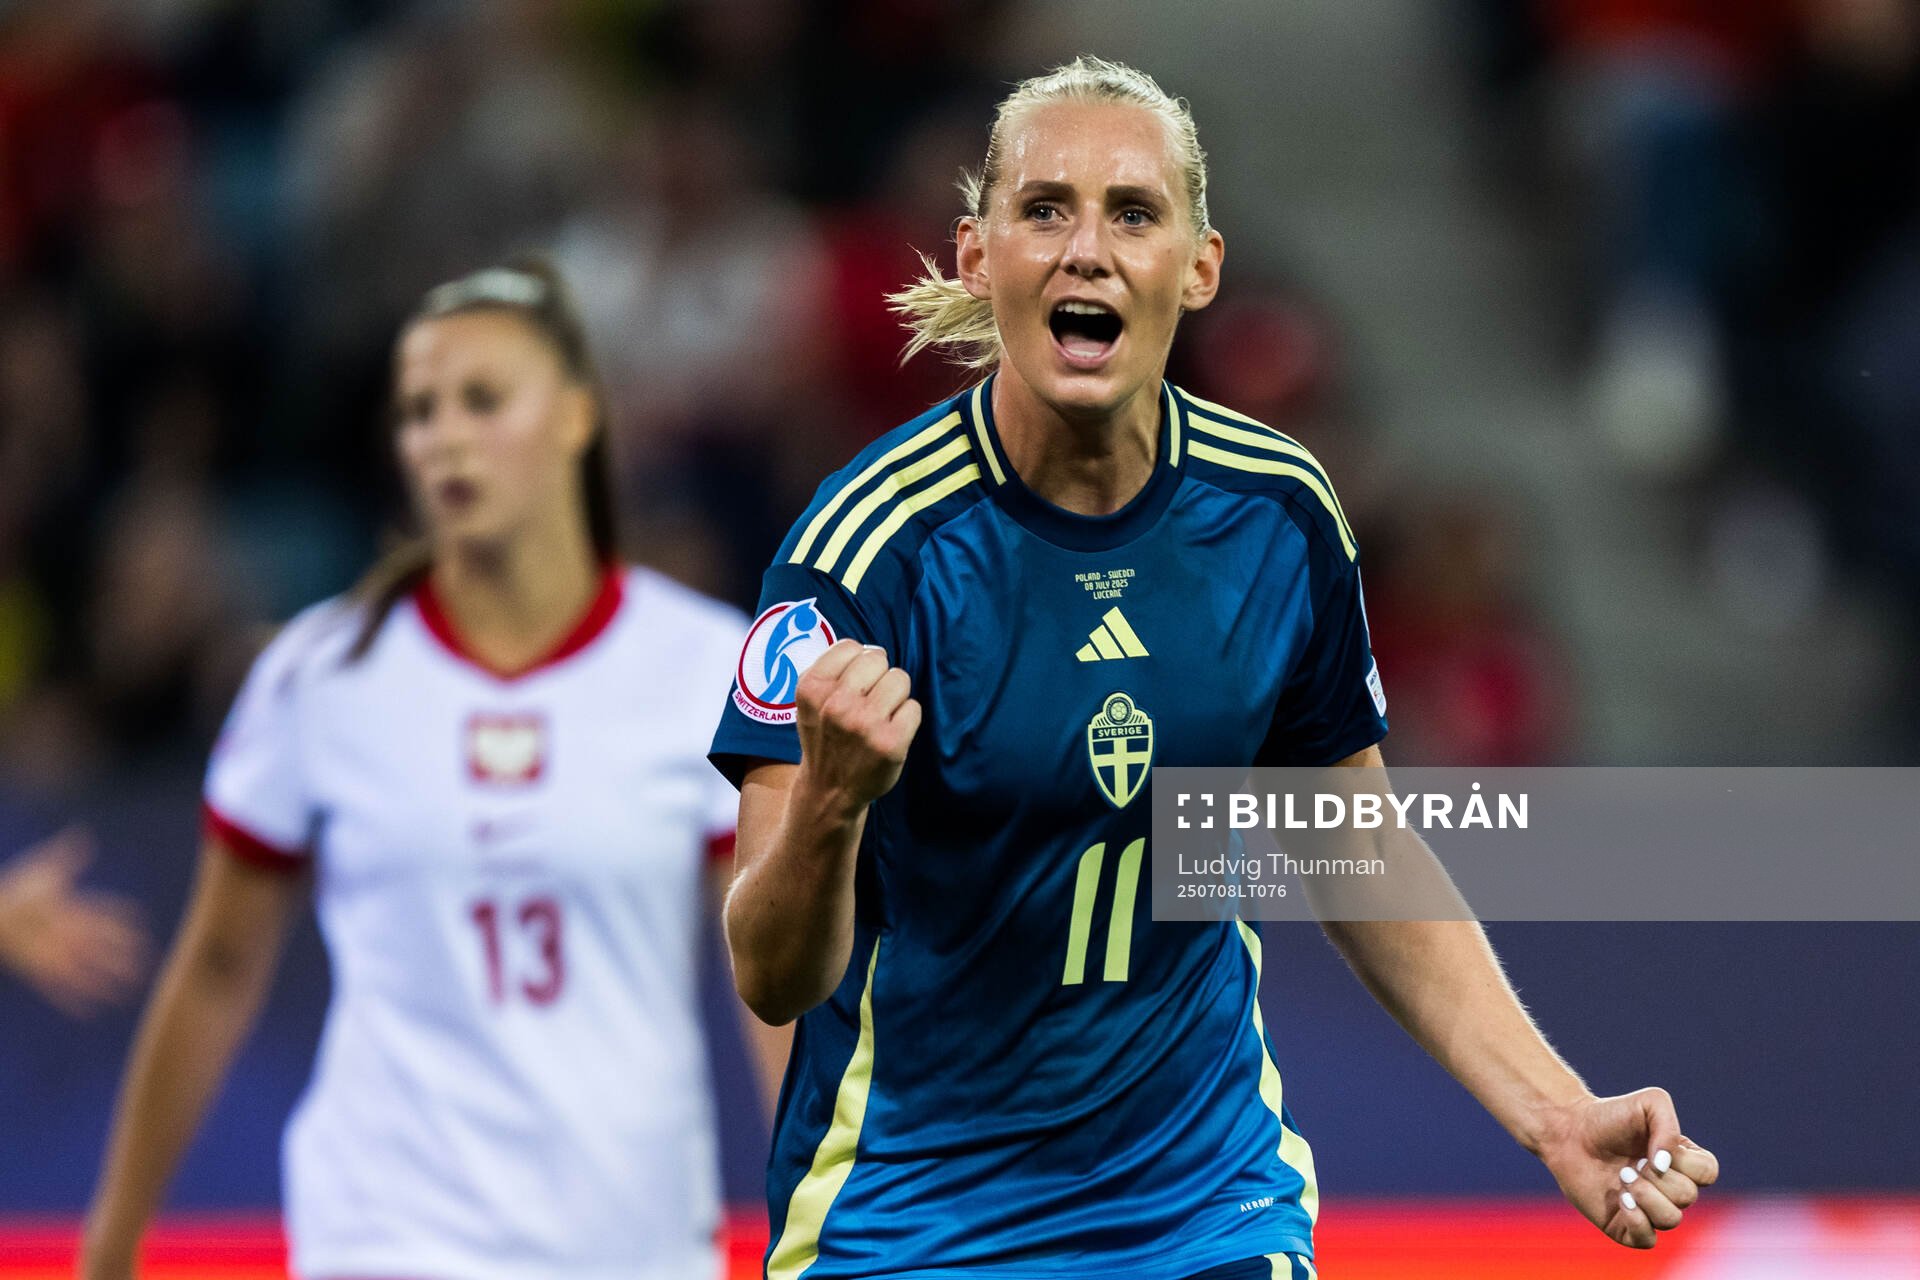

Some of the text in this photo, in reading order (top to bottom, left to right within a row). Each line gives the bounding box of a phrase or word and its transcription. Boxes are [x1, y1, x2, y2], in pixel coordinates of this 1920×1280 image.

[1075, 572, 1101, 583] POLAND
[1108, 568, 1135, 579] SWEDEN
[1095, 580, 1110, 590] JULY
[1111, 578, 1129, 588] 2025
[1093, 588, 1122, 600] LUCERNE
[735, 691, 792, 721] SWITZERLAND
[1097, 726, 1143, 738] SVERIGE
[1061, 836, 1146, 986] 11
[469, 898, 568, 1007] 13
